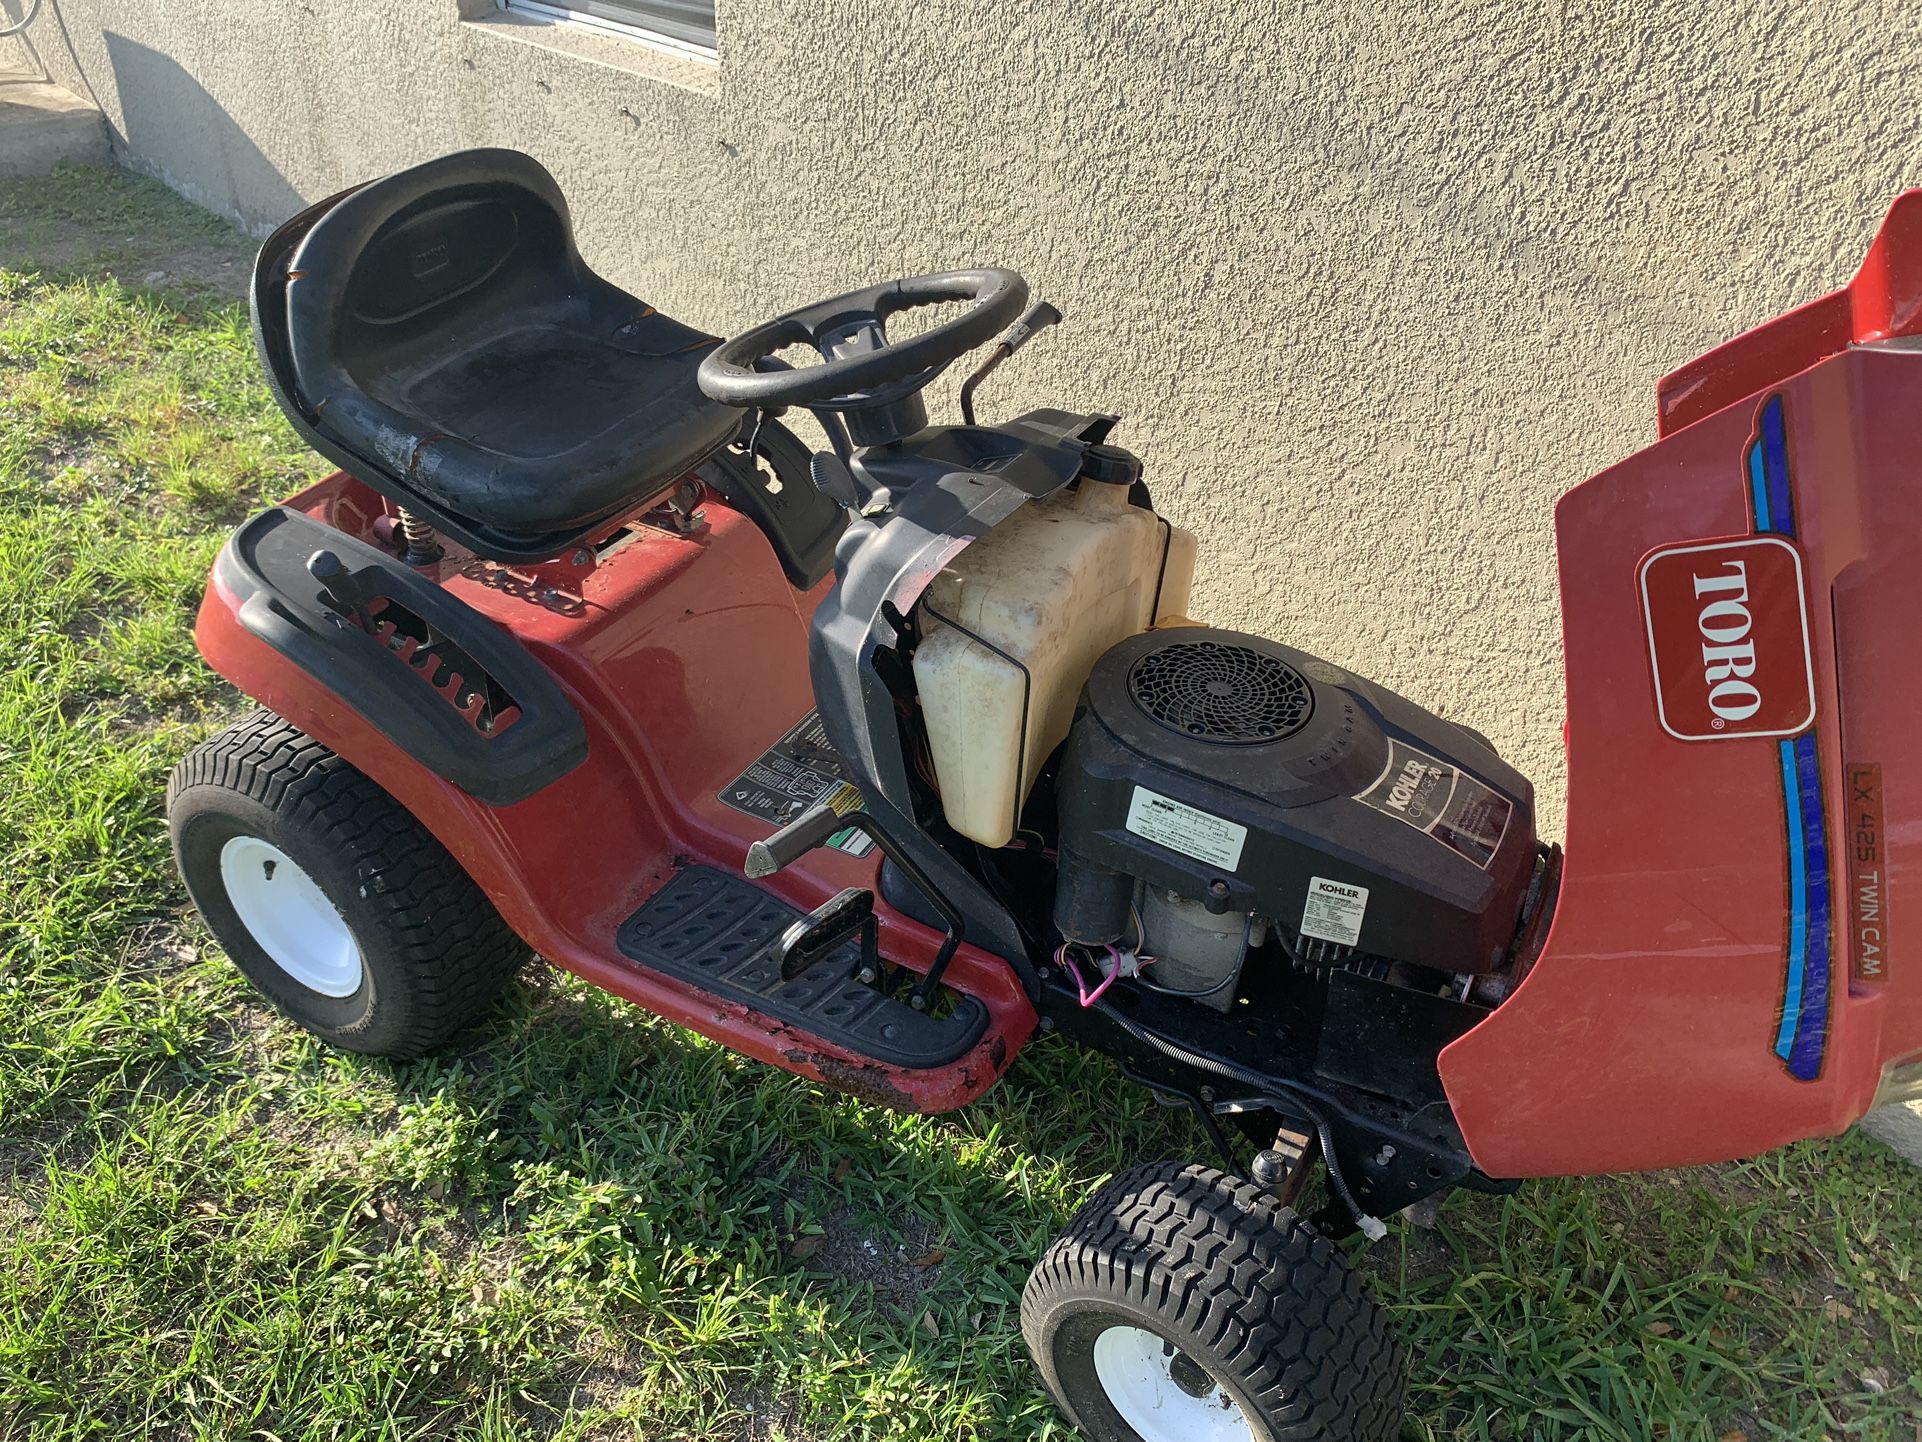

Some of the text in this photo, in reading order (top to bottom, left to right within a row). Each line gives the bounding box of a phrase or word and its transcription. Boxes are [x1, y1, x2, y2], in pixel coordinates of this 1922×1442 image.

[1693, 560, 1761, 720] TORO
[1385, 759, 1428, 812] KOHLER
[1408, 767, 1443, 818] COURAGE 20
[1319, 883, 1359, 899] KOHLER
[1852, 770, 1881, 975] LX 425 TWIN CAM
